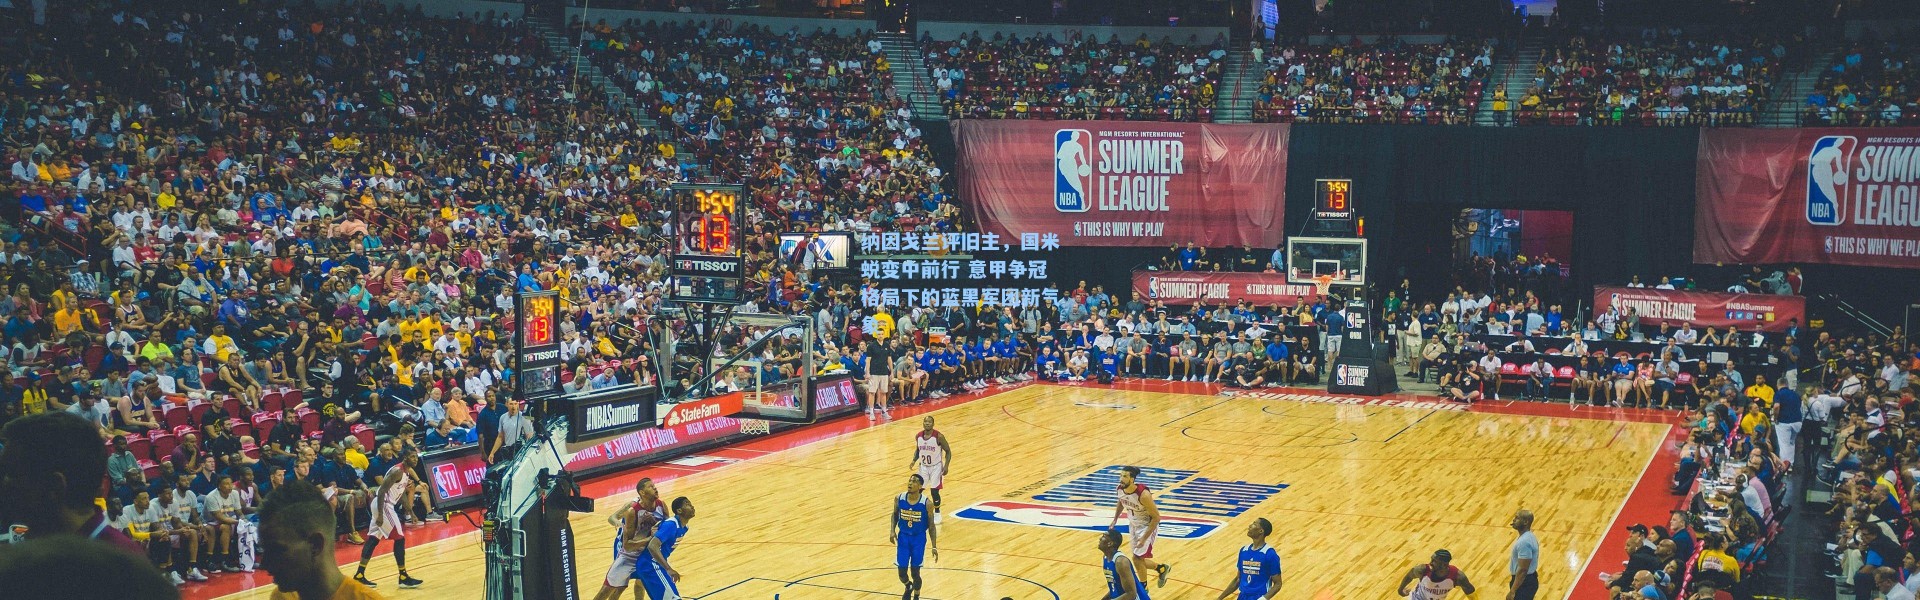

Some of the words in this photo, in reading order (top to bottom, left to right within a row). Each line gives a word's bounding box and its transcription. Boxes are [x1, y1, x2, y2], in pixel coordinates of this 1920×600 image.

[1098, 139, 1184, 174] SUMMER
[1098, 175, 1170, 211] LEAGUE
[1327, 182, 1348, 193] 7:54
[695, 191, 736, 215] 7:54
[1059, 192, 1077, 206] NBA
[1330, 193, 1345, 209] 13
[1854, 184, 1920, 227] LEAGU
[1811, 202, 1830, 218] NBA
[699, 215, 730, 254] 13
[1083, 221, 1101, 237] THIS
[1103, 221, 1111, 237] IS
[1112, 222, 1131, 237] WHY
[1132, 222, 1144, 237] WE
[1145, 222, 1164, 237] PLAY
[1834, 236, 1855, 254] THIS
[1856, 236, 1866, 254] IS
[1867, 238, 1890, 256] WHY
[1890, 239, 1904, 257] WE
[692, 260, 738, 272] TISSOT
[1159, 282, 1198, 298] SUMMER
[1252, 284, 1266, 295] THIS
[1266, 284, 1273, 295] IS
[1273, 285, 1286, 296] WHY
[1287, 285, 1296, 295] WE
[1296, 285, 1311, 296] PLAY
[532, 297, 554, 318] 7:54
[1662, 302, 1697, 321] LEAGUE
[1725, 302, 1775, 312] #NBASummer
[534, 318, 549, 342] 13
[533, 349, 560, 361] TISSOT
[1347, 367, 1369, 378] SUMMER
[1347, 376, 1365, 387] LEAGUE
[586, 403, 640, 432] #NBASummer
[612, 429, 651, 457] SUMMER
[650, 427, 679, 449] LEAGUE
[686, 421, 705, 436] MGM
[704, 415, 736, 432] RESORTS
[921, 454, 932, 465] 20
[444, 470, 458, 491] TV
[907, 520, 913, 528] 6
[560, 528, 568, 548] MGM
[562, 548, 571, 583] RESORTS
